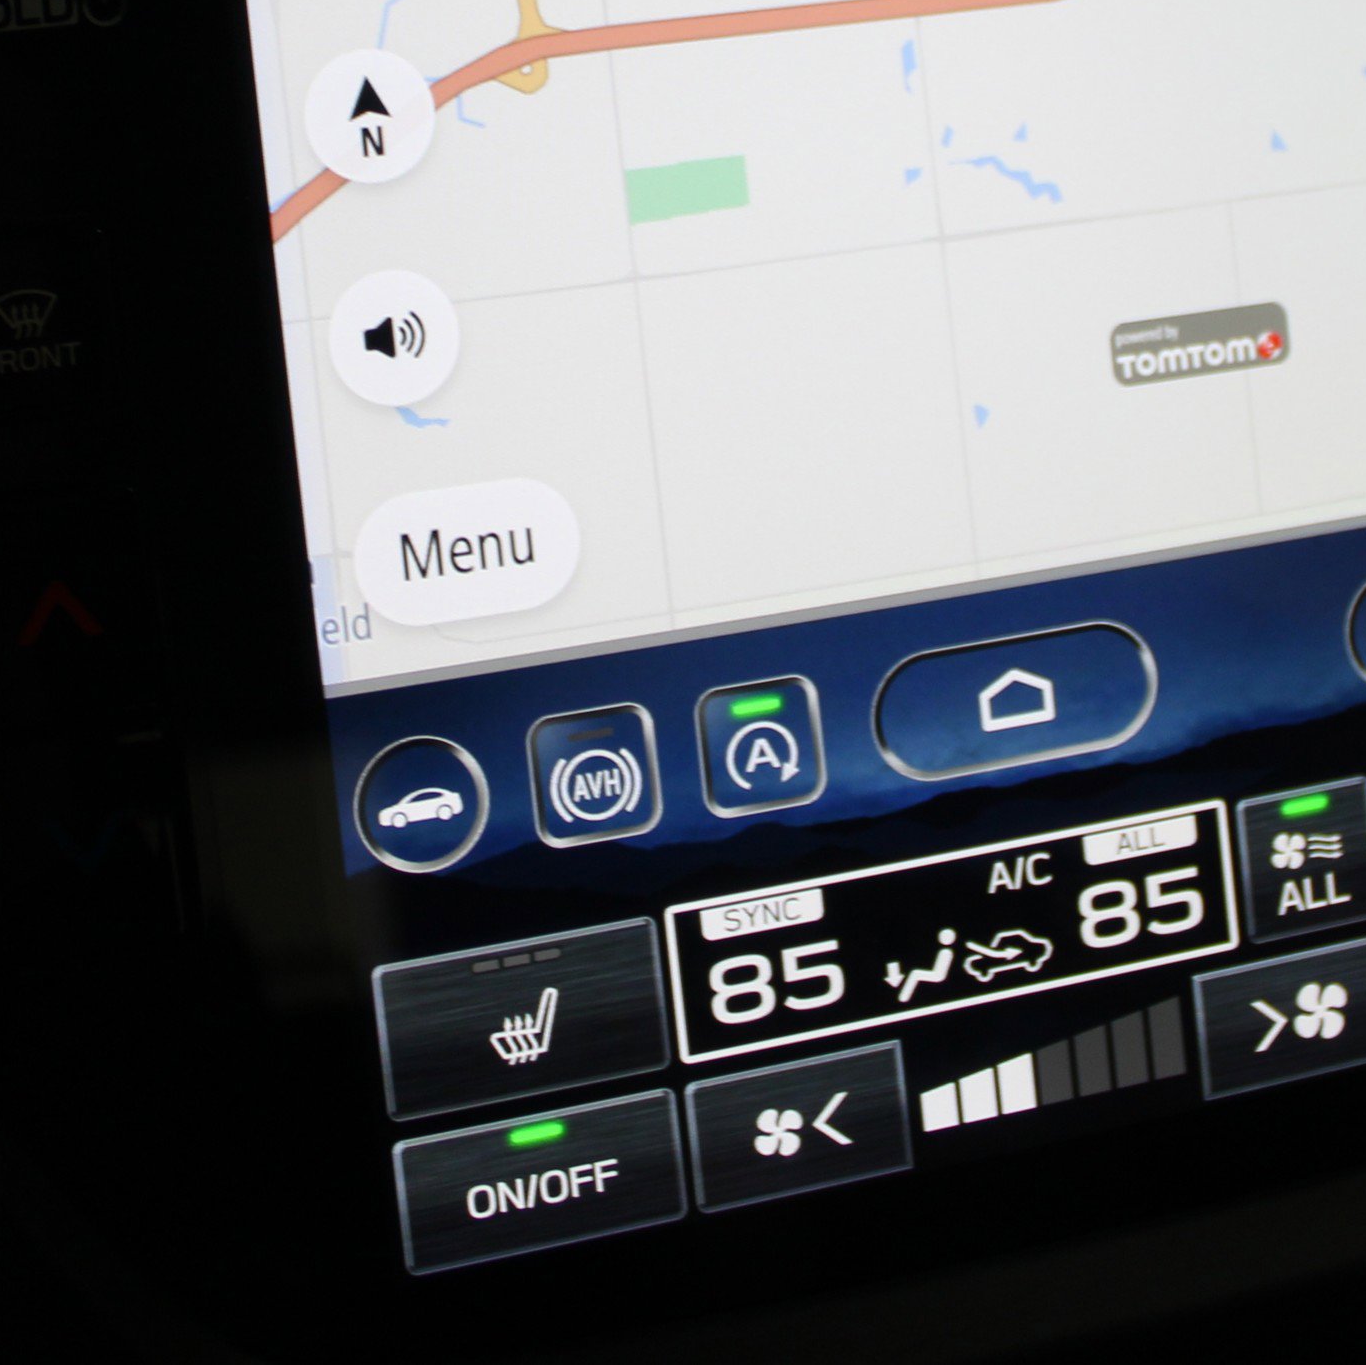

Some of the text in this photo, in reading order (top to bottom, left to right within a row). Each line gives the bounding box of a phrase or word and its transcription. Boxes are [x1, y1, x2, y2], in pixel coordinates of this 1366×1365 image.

[361, 126, 385, 157] N
[399, 527, 535, 582] Menu
[572, 768, 622, 802] AVH
[1115, 829, 1166, 856] ALL
[988, 853, 1053, 894] A/C
[1277, 872, 1352, 916] ALL
[723, 897, 803, 932] SYNC
[1077, 866, 1205, 950] 85
[708, 940, 845, 1025] 85
[466, 1158, 619, 1220] ON/OFF
